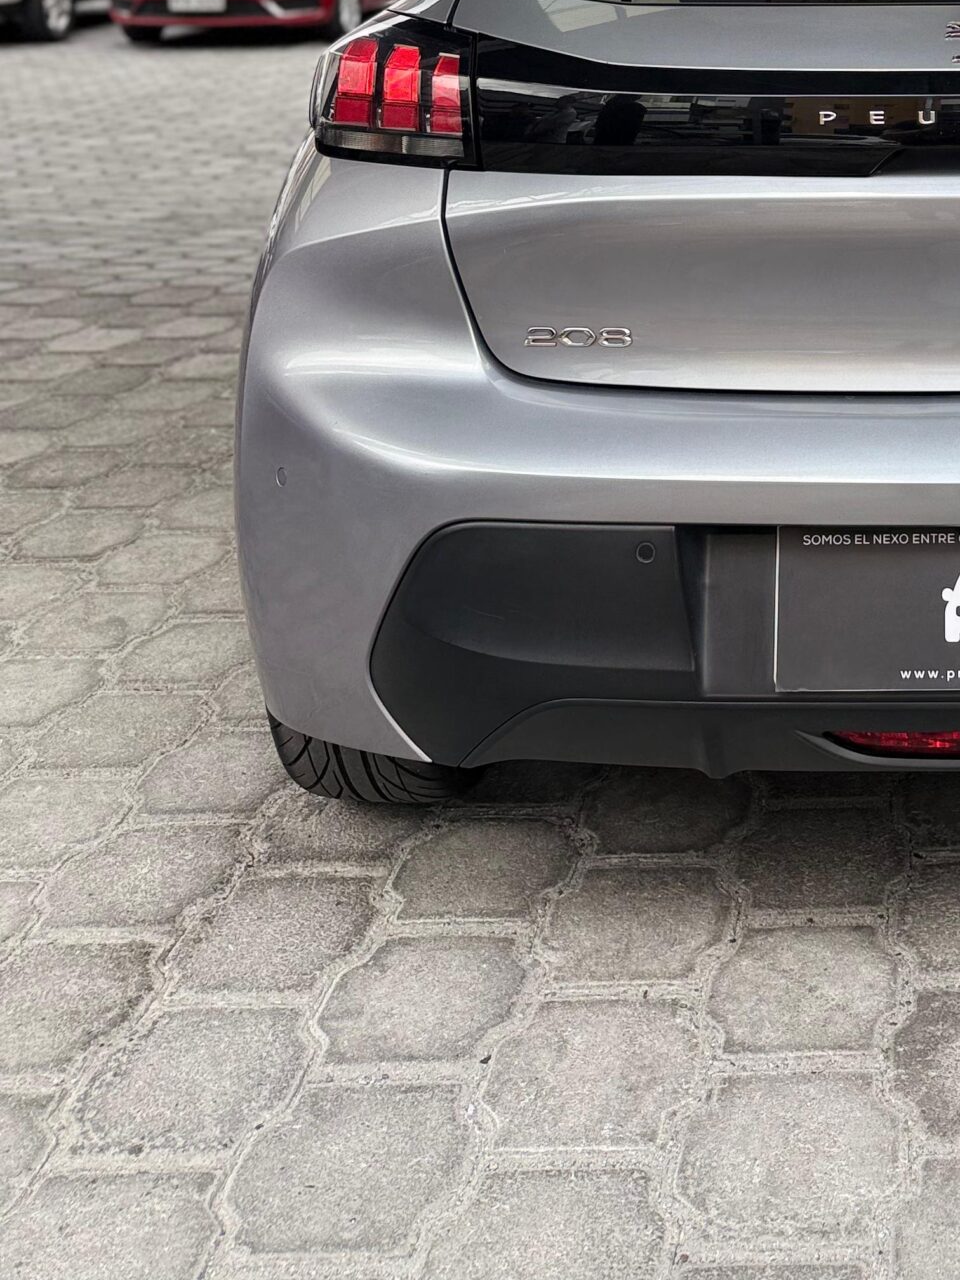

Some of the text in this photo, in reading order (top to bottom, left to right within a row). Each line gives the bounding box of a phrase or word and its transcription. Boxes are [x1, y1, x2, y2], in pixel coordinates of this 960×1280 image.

[524, 326, 633, 347] 208
[803, 533, 851, 546] SOMOS
[854, 533, 870, 545] EL
[872, 533, 909, 545] NEXO
[912, 533, 955, 545] ENTRE
